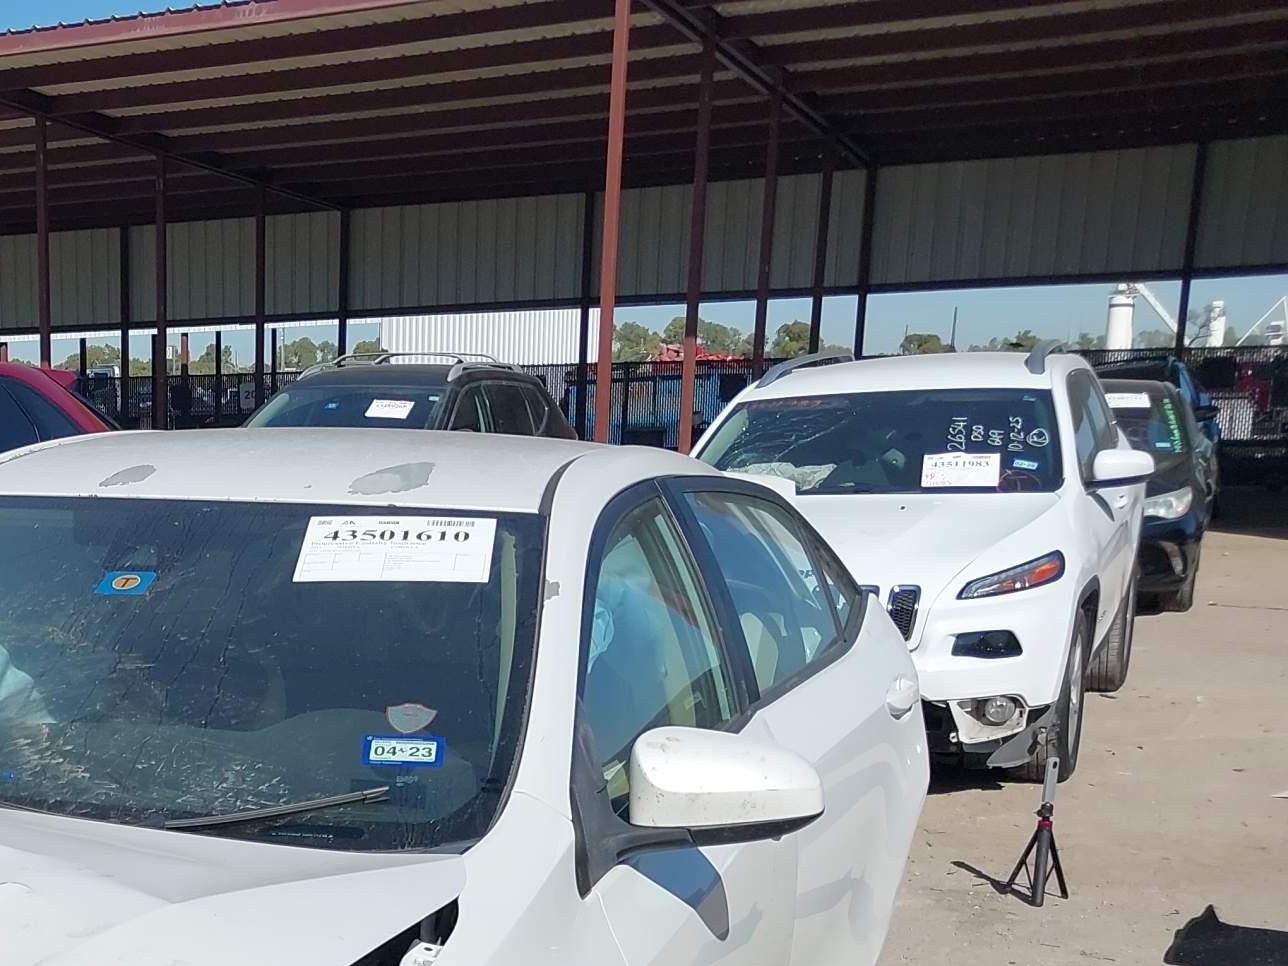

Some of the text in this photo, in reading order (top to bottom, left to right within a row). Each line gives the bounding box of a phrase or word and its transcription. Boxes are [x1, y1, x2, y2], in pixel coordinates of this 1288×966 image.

[931, 460, 990, 468] 43511983
[323, 529, 470, 542] 43501610
[374, 746, 433, 757] 04 23
